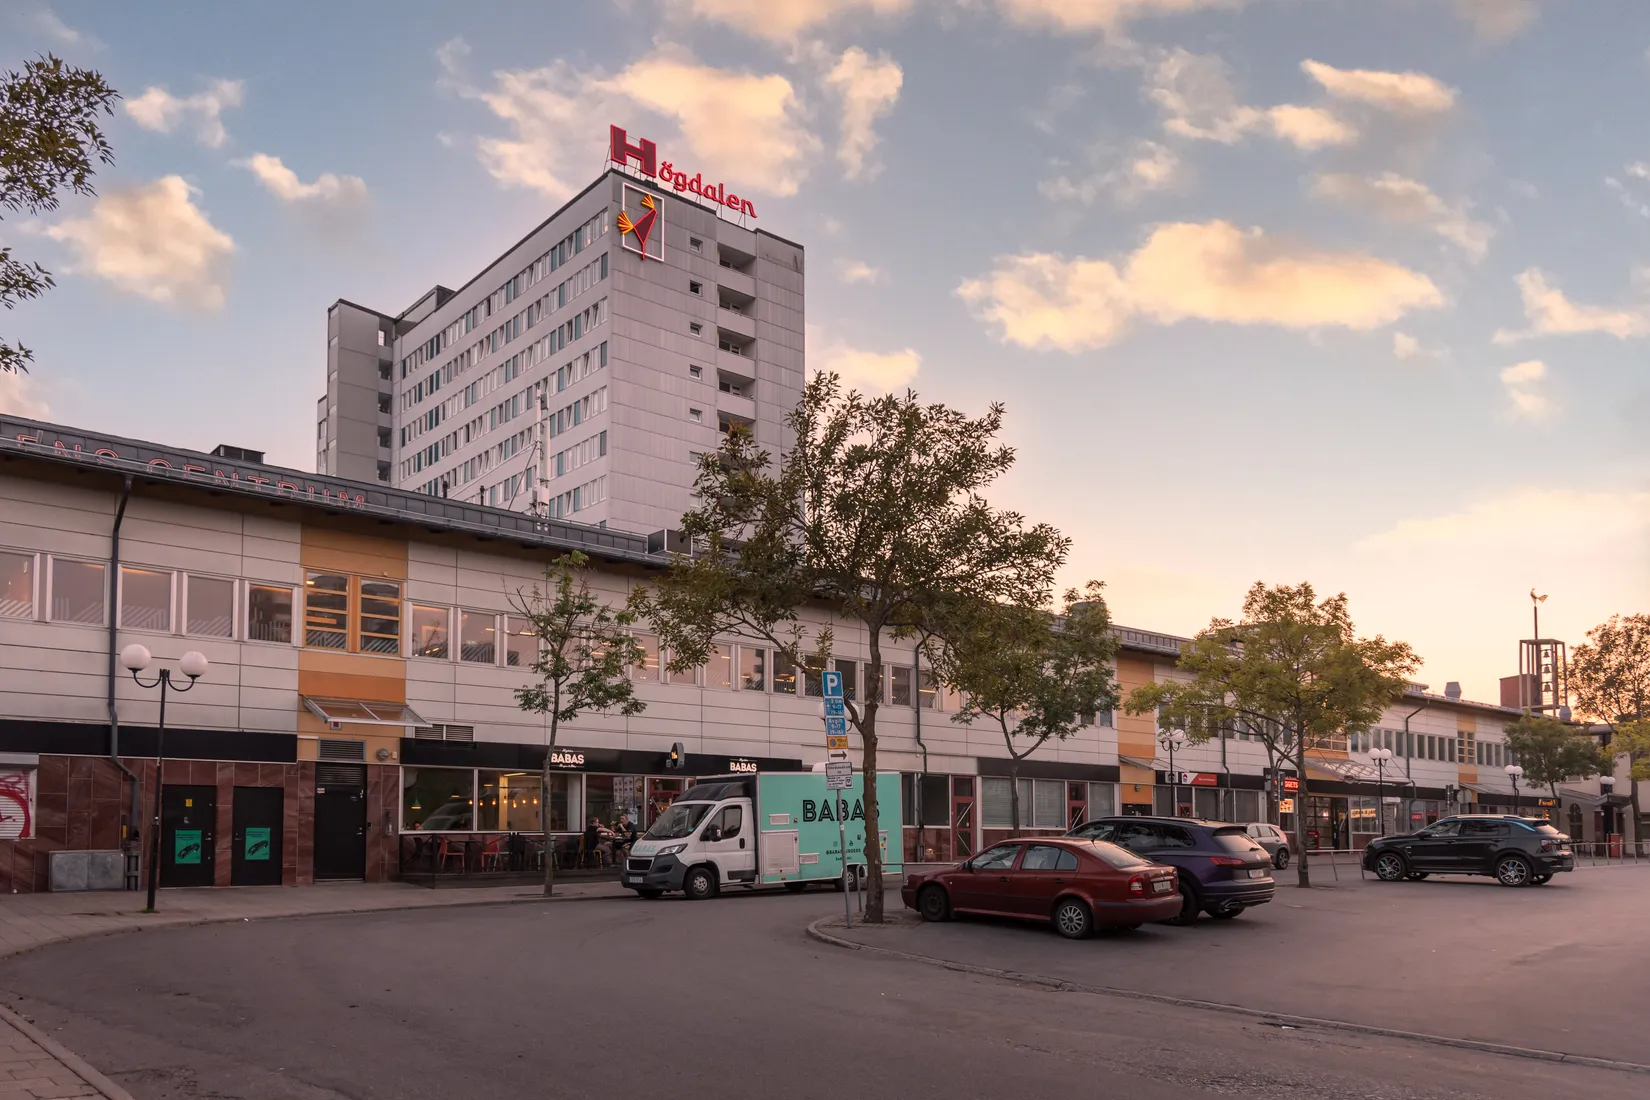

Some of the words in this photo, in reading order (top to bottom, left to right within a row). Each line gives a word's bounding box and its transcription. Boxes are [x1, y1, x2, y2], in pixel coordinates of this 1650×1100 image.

[611, 124, 758, 219] Högdalen
[827, 674, 838, 695] P
[551, 753, 585, 764] BABAS
[730, 762, 757, 772] BABAS
[802, 798, 880, 822] BABA
[633, 845, 656, 853] BABAS
